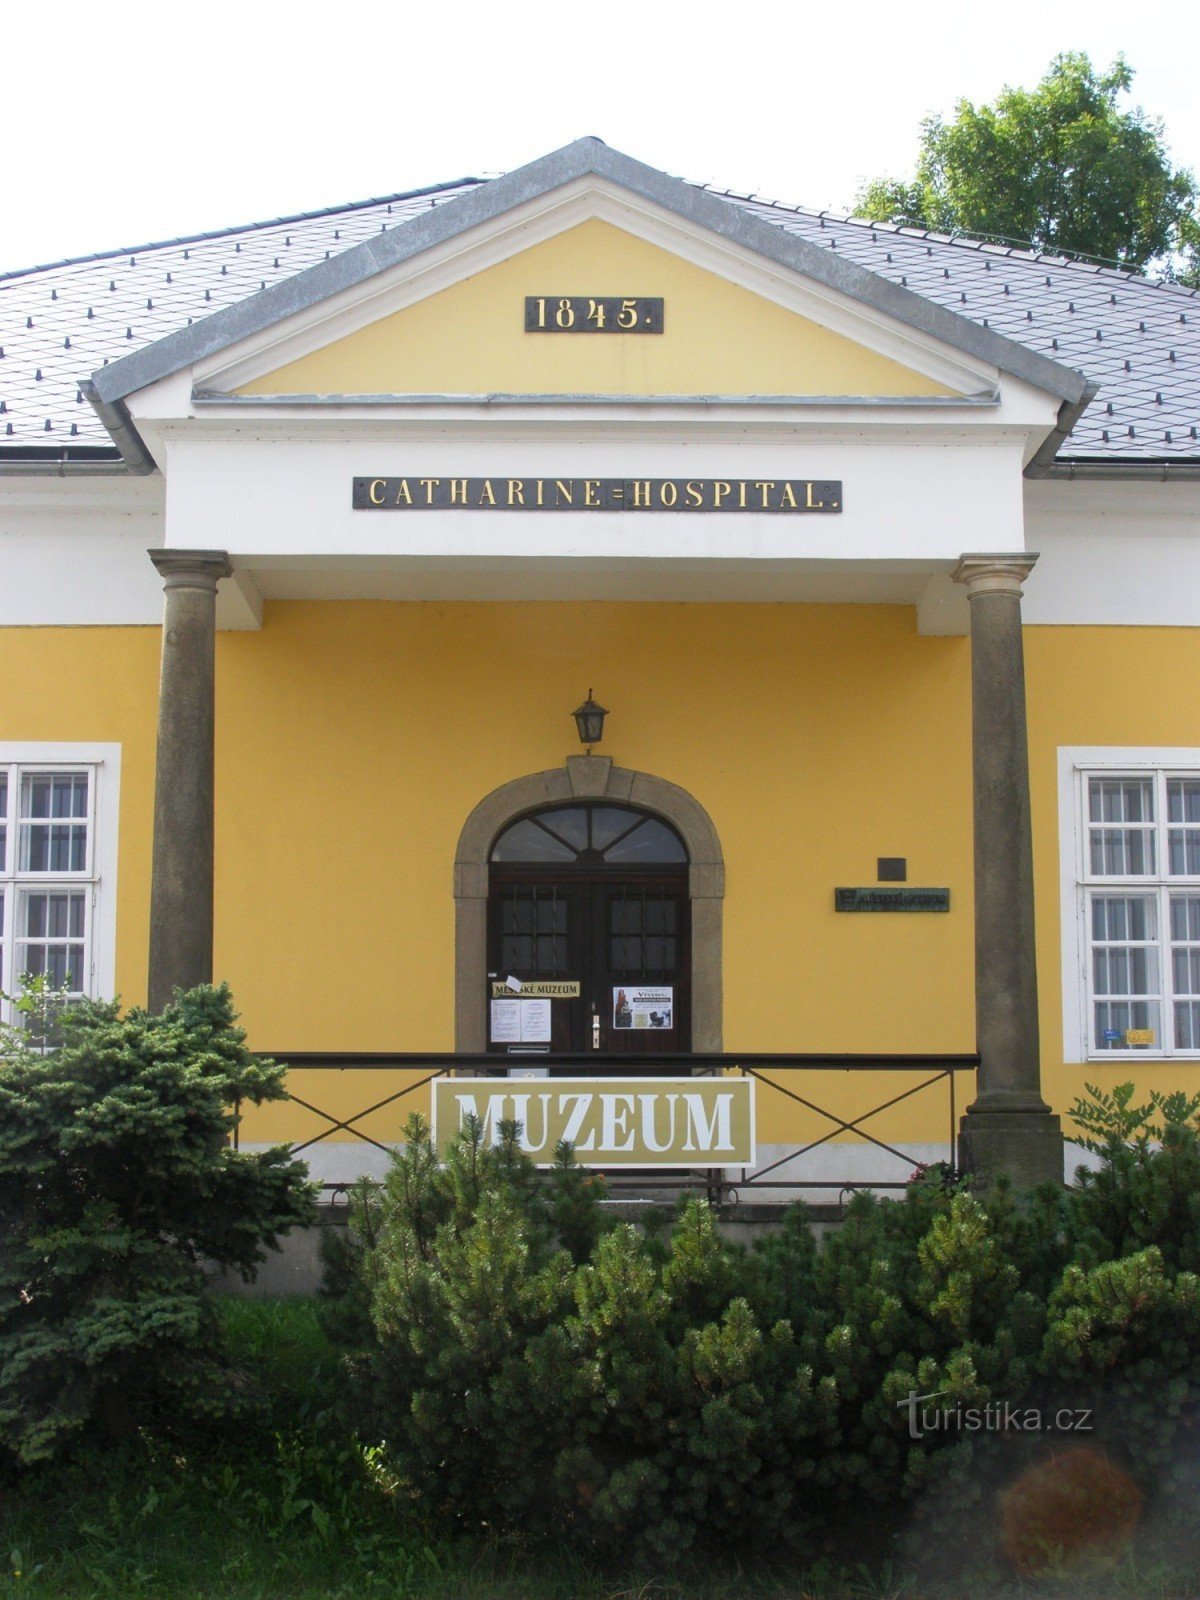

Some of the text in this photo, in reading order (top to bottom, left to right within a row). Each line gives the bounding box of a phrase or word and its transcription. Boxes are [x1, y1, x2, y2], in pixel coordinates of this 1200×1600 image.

[536, 299, 651, 328] 1845.
[537, 985, 577, 994] MUZEUM
[454, 1093, 734, 1152] MUZEUM
